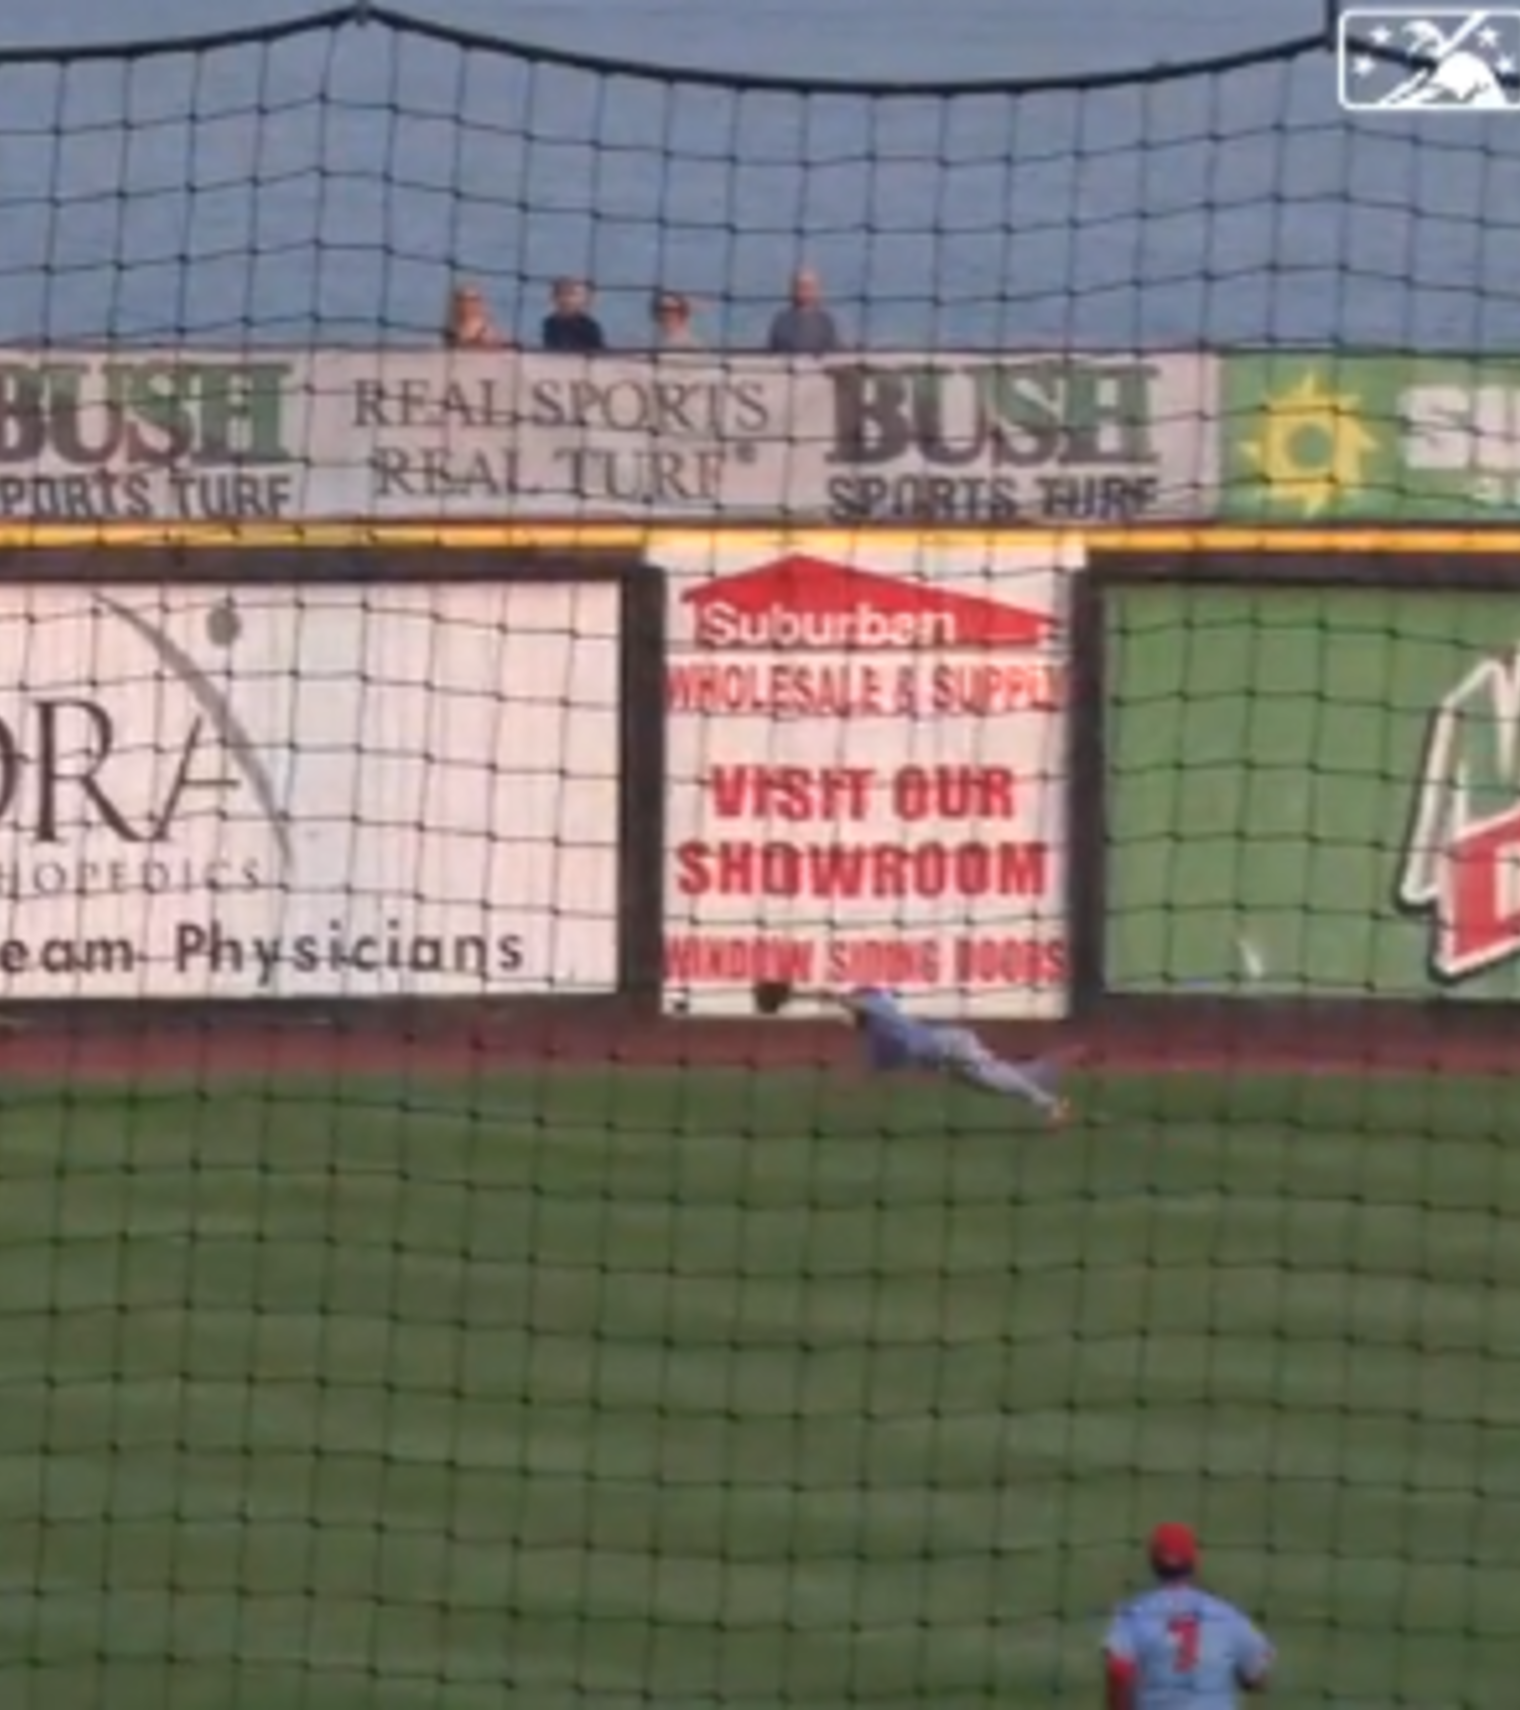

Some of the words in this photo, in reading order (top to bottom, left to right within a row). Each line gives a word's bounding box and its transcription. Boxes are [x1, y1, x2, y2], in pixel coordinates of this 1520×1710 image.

[352, 379, 520, 428] REAL
[533, 379, 770, 432] SPORTS
[823, 364, 1162, 466] BUSH
[172, 474, 291, 518] TURF
[378, 448, 522, 498] REAL
[828, 475, 1018, 522] SPORTS
[1036, 476, 1157, 518] TURF
[702, 600, 958, 646] Suburban
[666, 664, 888, 714] WHOLESALE
[711, 764, 875, 822] VISIT
[892, 766, 1014, 822] OUR
[677, 840, 1048, 899] SHOWROOM
[177, 919, 525, 986] Physicians
[667, 936, 812, 984] WINDOW
[829, 938, 940, 984] SIDING
[954, 938, 1064, 982] DOORS
